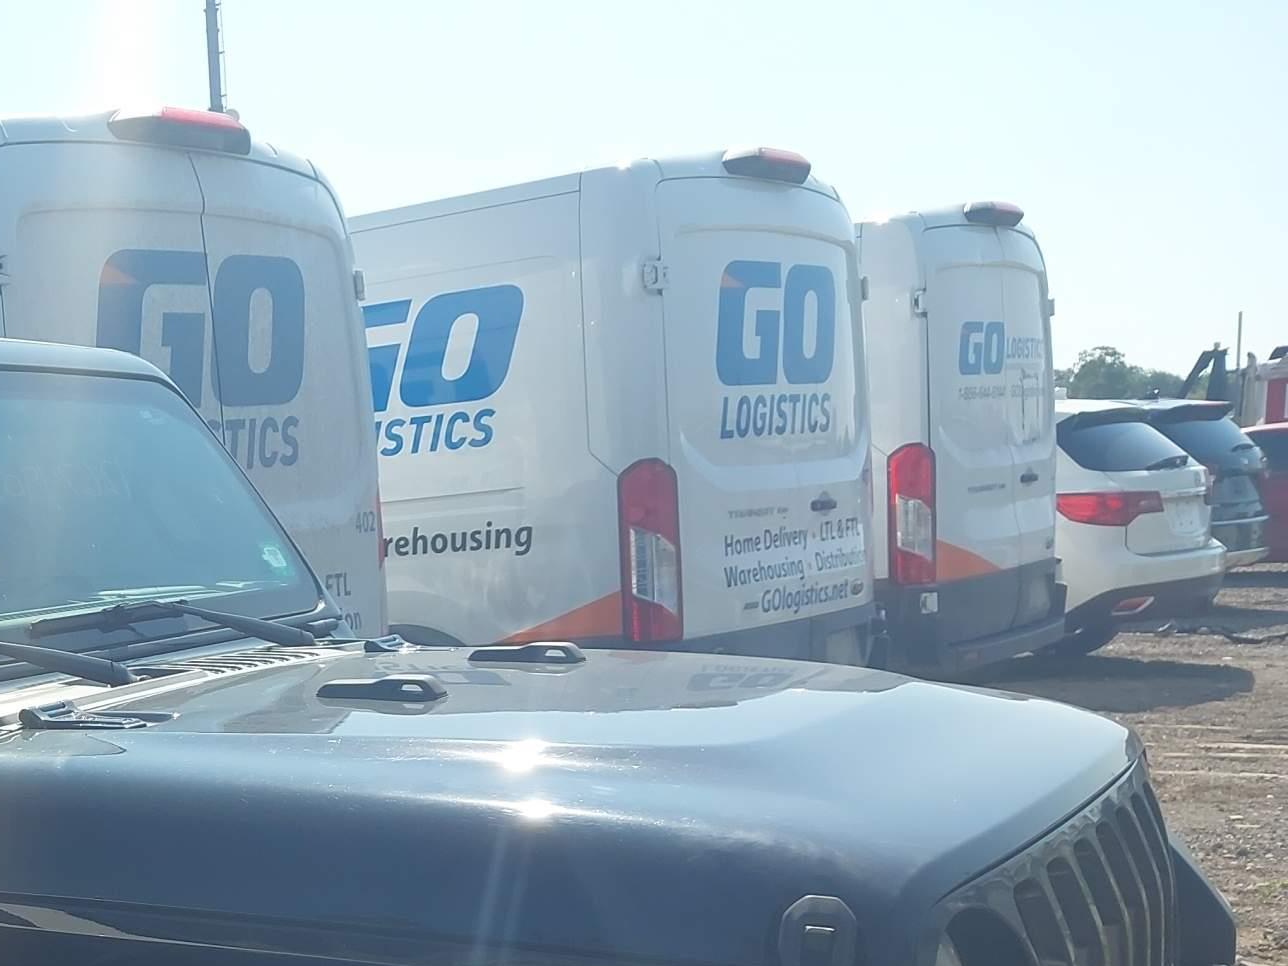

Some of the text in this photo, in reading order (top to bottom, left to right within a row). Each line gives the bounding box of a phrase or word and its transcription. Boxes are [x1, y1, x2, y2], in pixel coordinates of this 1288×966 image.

[95, 249, 305, 408] GO
[716, 260, 835, 386] GO
[959, 321, 1004, 375] GO
[720, 393, 831, 439] LOGISTICS
[724, 534, 761, 557] Home
[763, 526, 809, 550] Delivery
[724, 557, 805, 588] Warehousing
